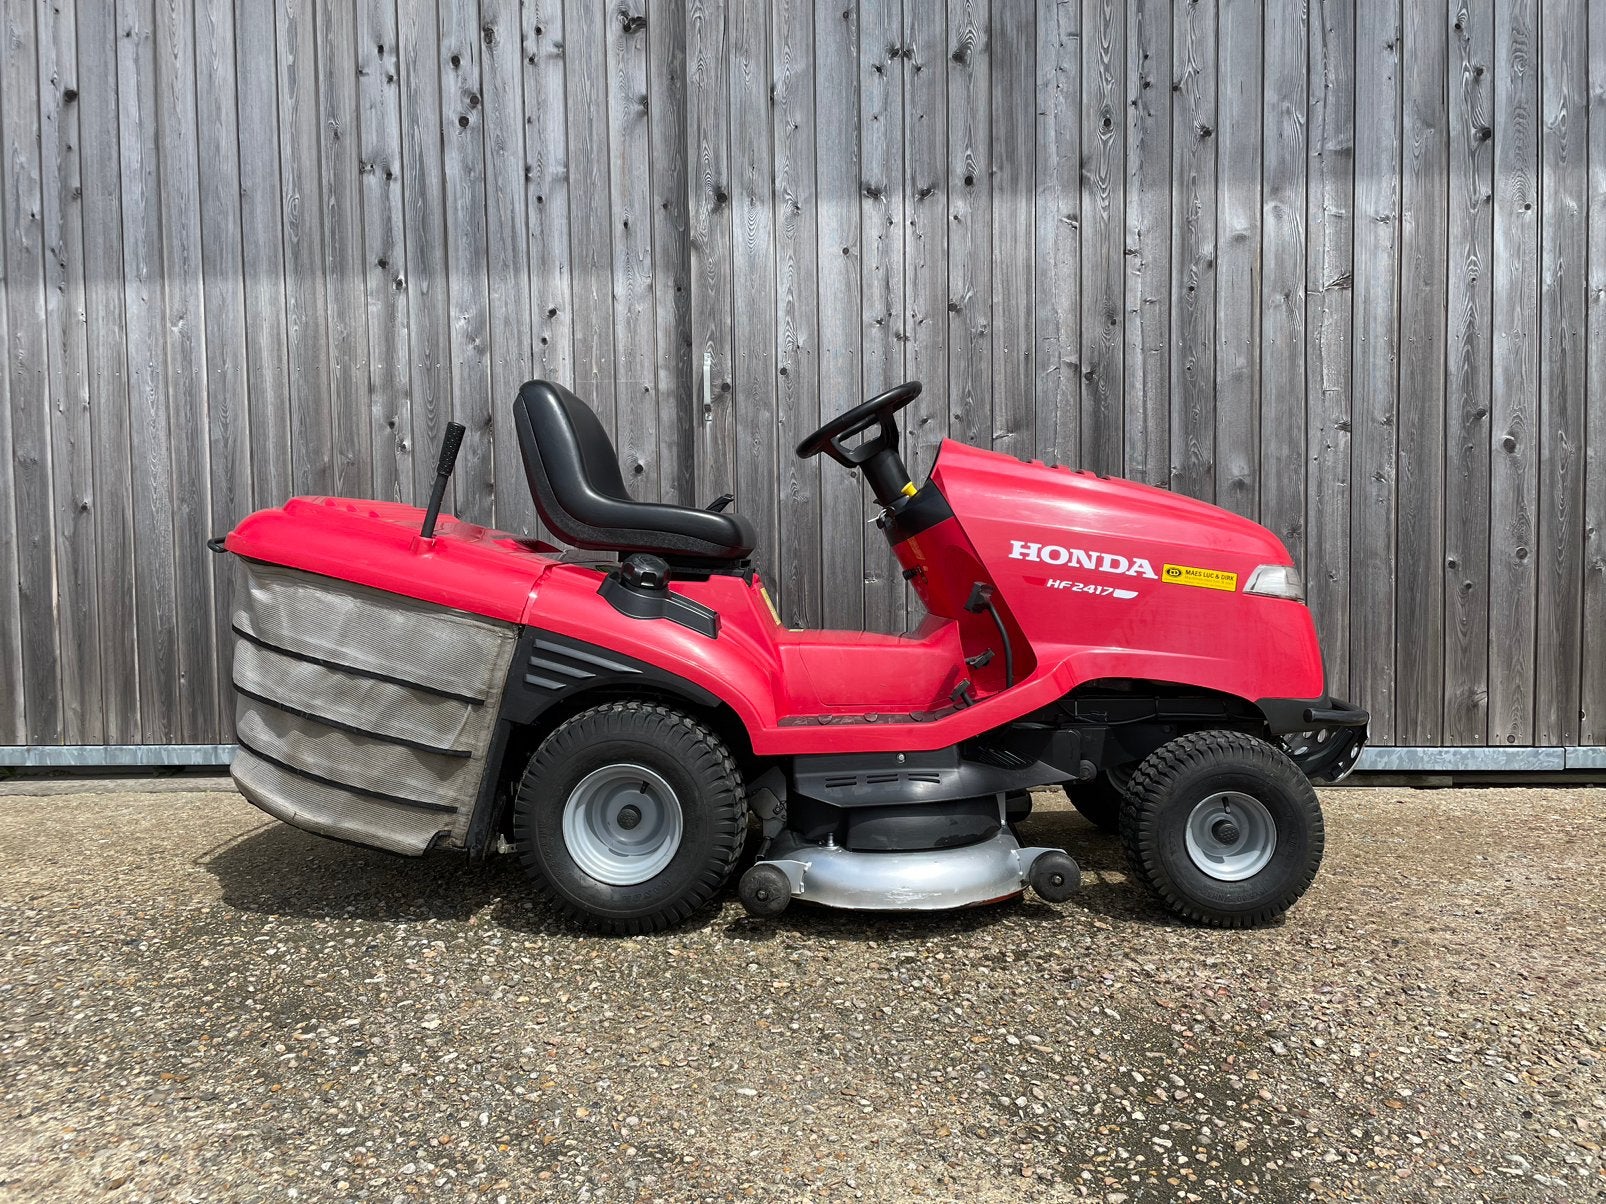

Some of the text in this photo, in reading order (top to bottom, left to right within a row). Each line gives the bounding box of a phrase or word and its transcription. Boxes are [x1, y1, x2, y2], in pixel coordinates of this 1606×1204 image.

[1009, 541, 1158, 579] HONDA
[1185, 569, 1202, 577] MAES
[1203, 571, 1215, 579] LUC
[1220, 574, 1235, 582] DIRK
